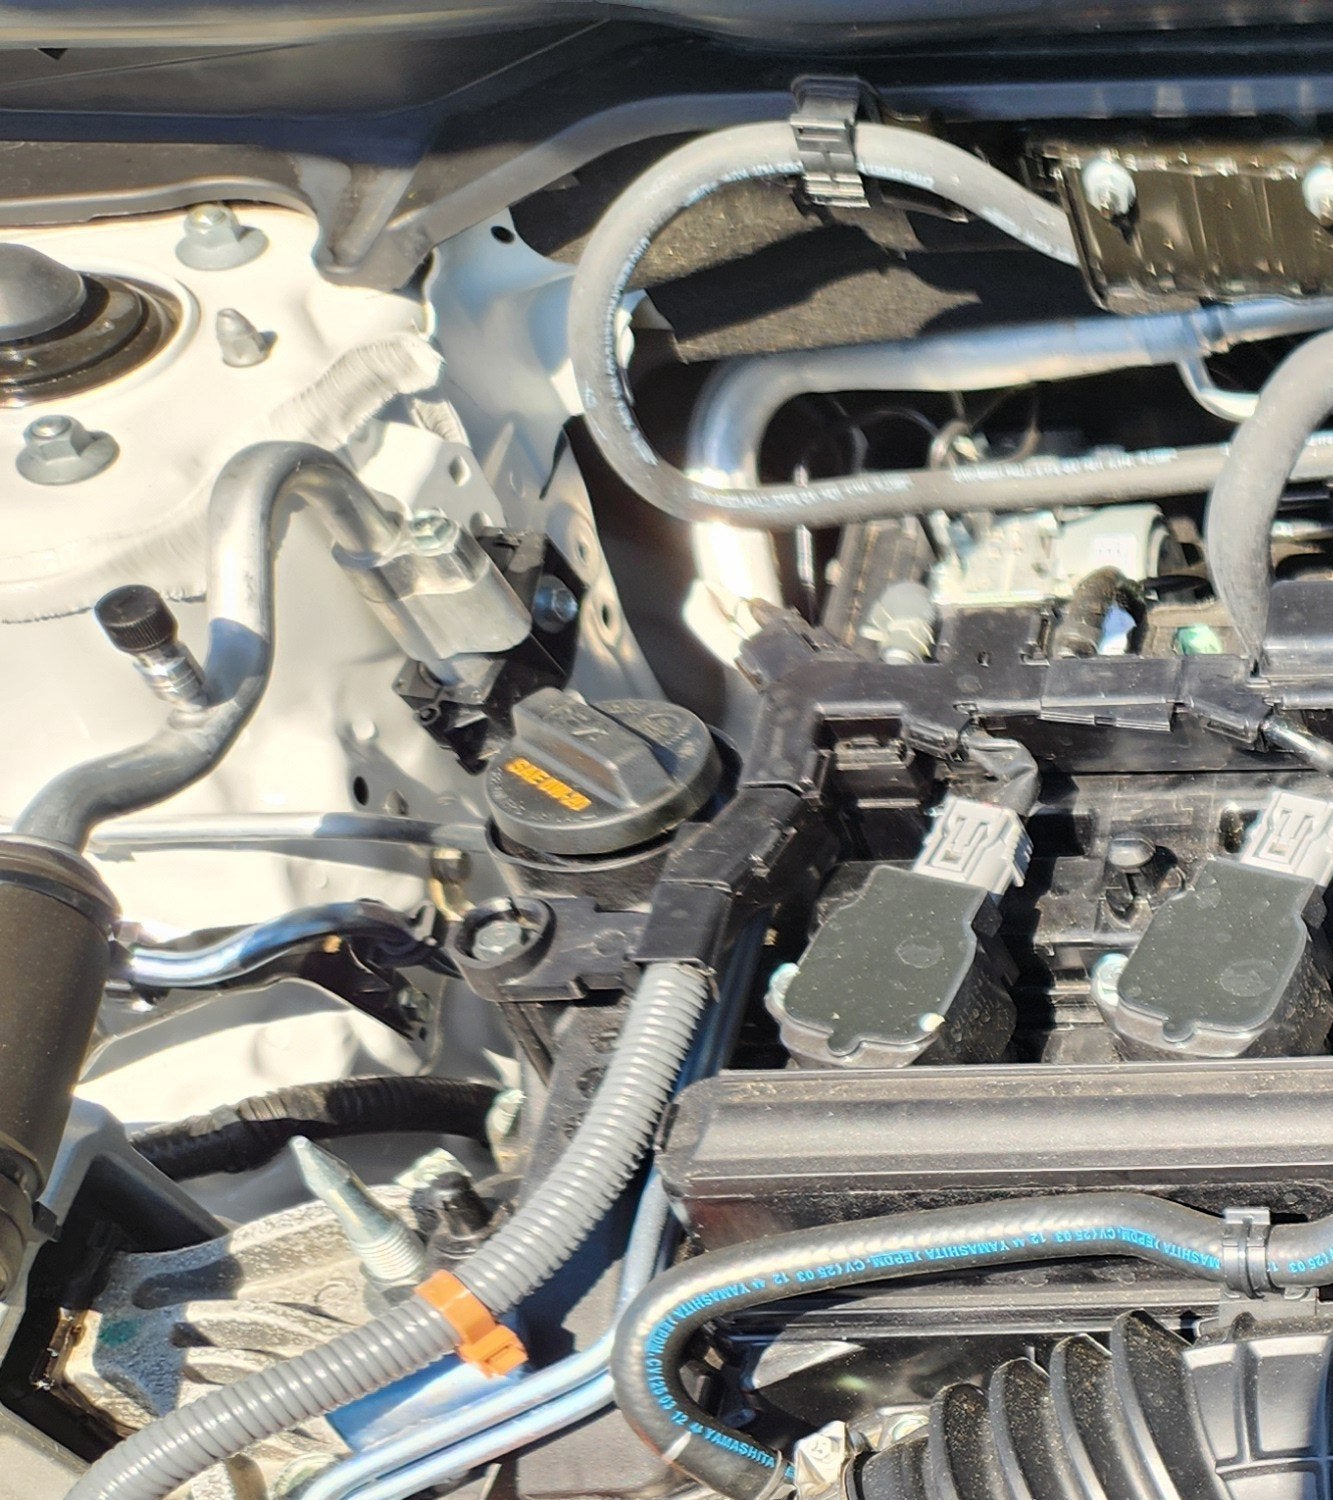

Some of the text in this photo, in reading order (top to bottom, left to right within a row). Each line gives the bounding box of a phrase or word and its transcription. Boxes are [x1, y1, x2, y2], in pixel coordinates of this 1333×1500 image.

[1031, 1232, 1047, 1245] 12
[925, 1239, 1010, 1261] YAMASHITA
[772, 1273, 791, 1285] 12
[673, 1282, 751, 1322] YAMASHITA
[670, 1410, 690, 1426] 12
[703, 1426, 775, 1468] YAMASHITA
